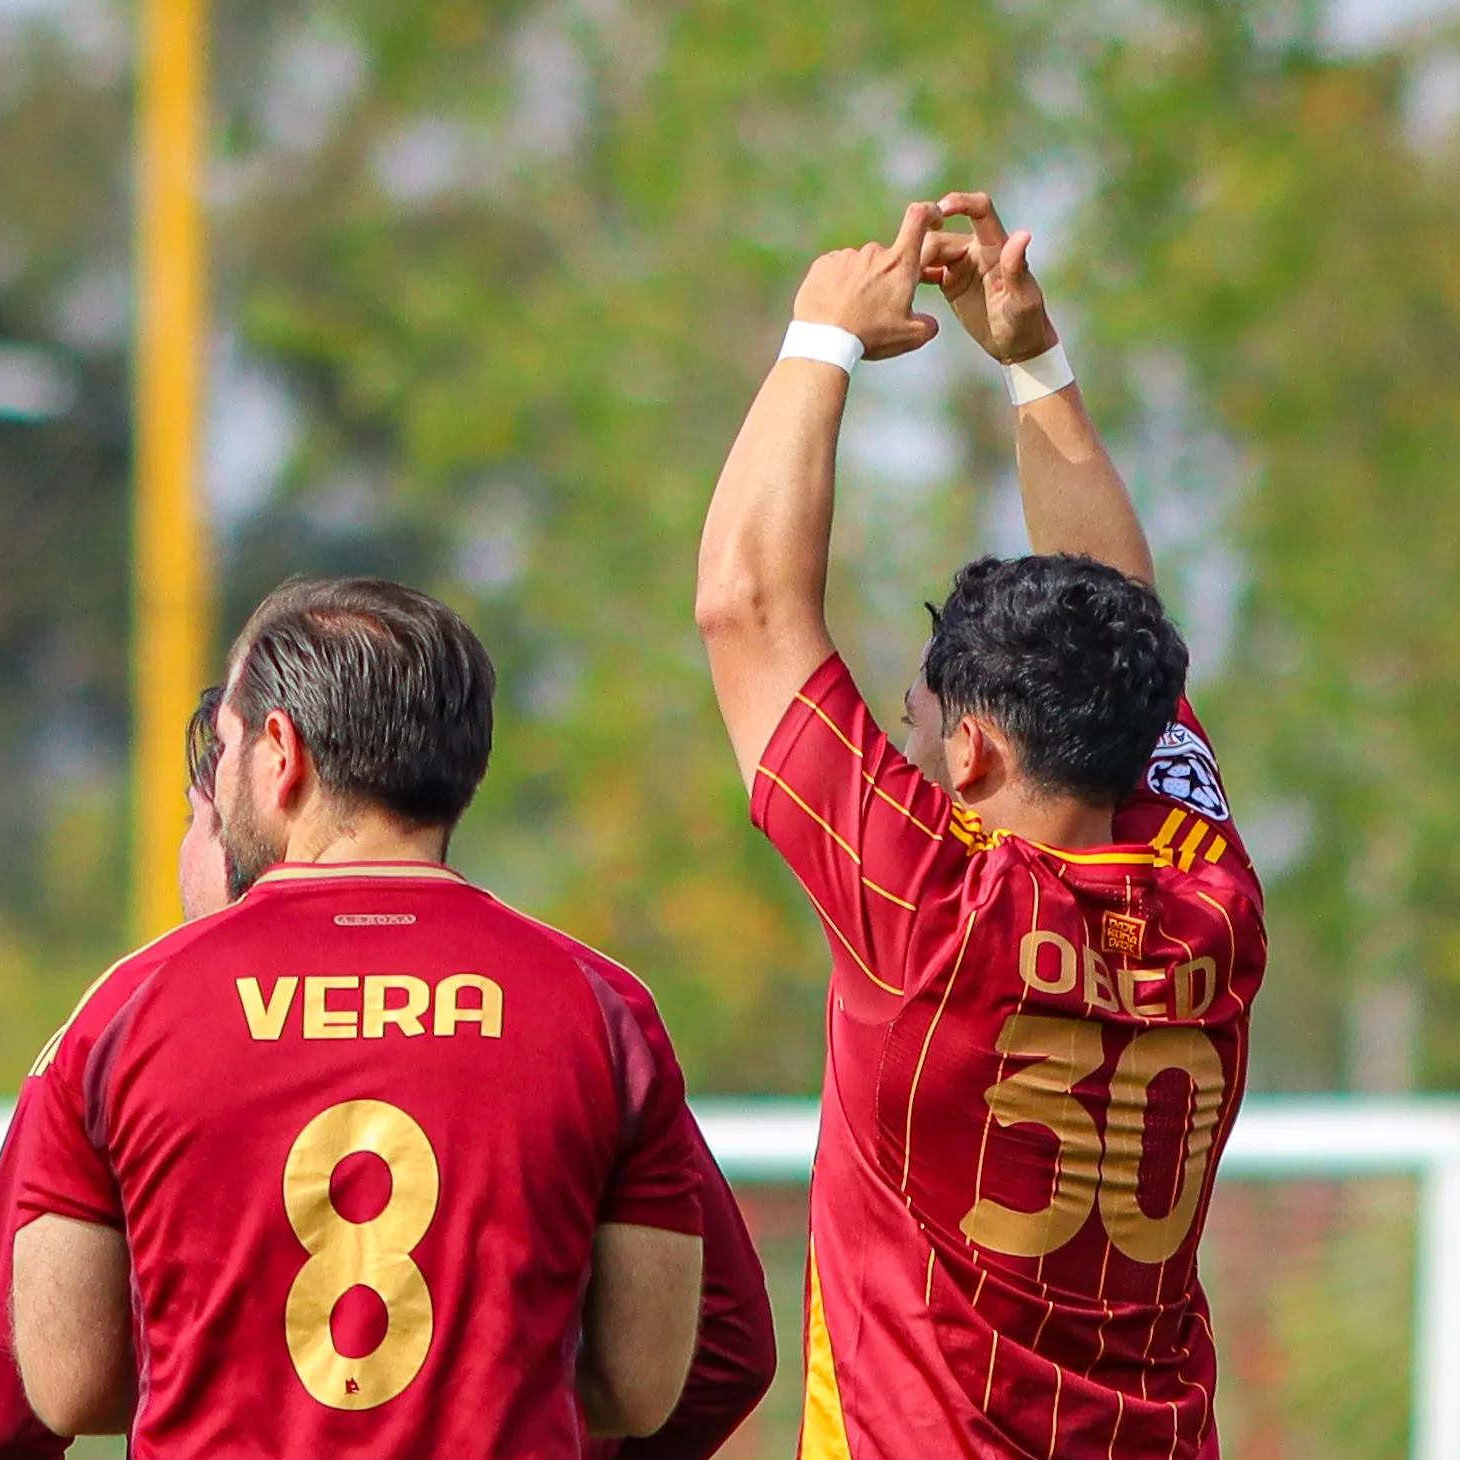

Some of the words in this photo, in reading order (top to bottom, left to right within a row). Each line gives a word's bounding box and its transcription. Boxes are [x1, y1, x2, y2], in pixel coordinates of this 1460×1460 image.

[235, 973, 504, 1041] VERA
[1018, 930, 1216, 1022] OBED
[959, 1014, 1224, 1264] 30
[282, 1099, 440, 1411] 8
